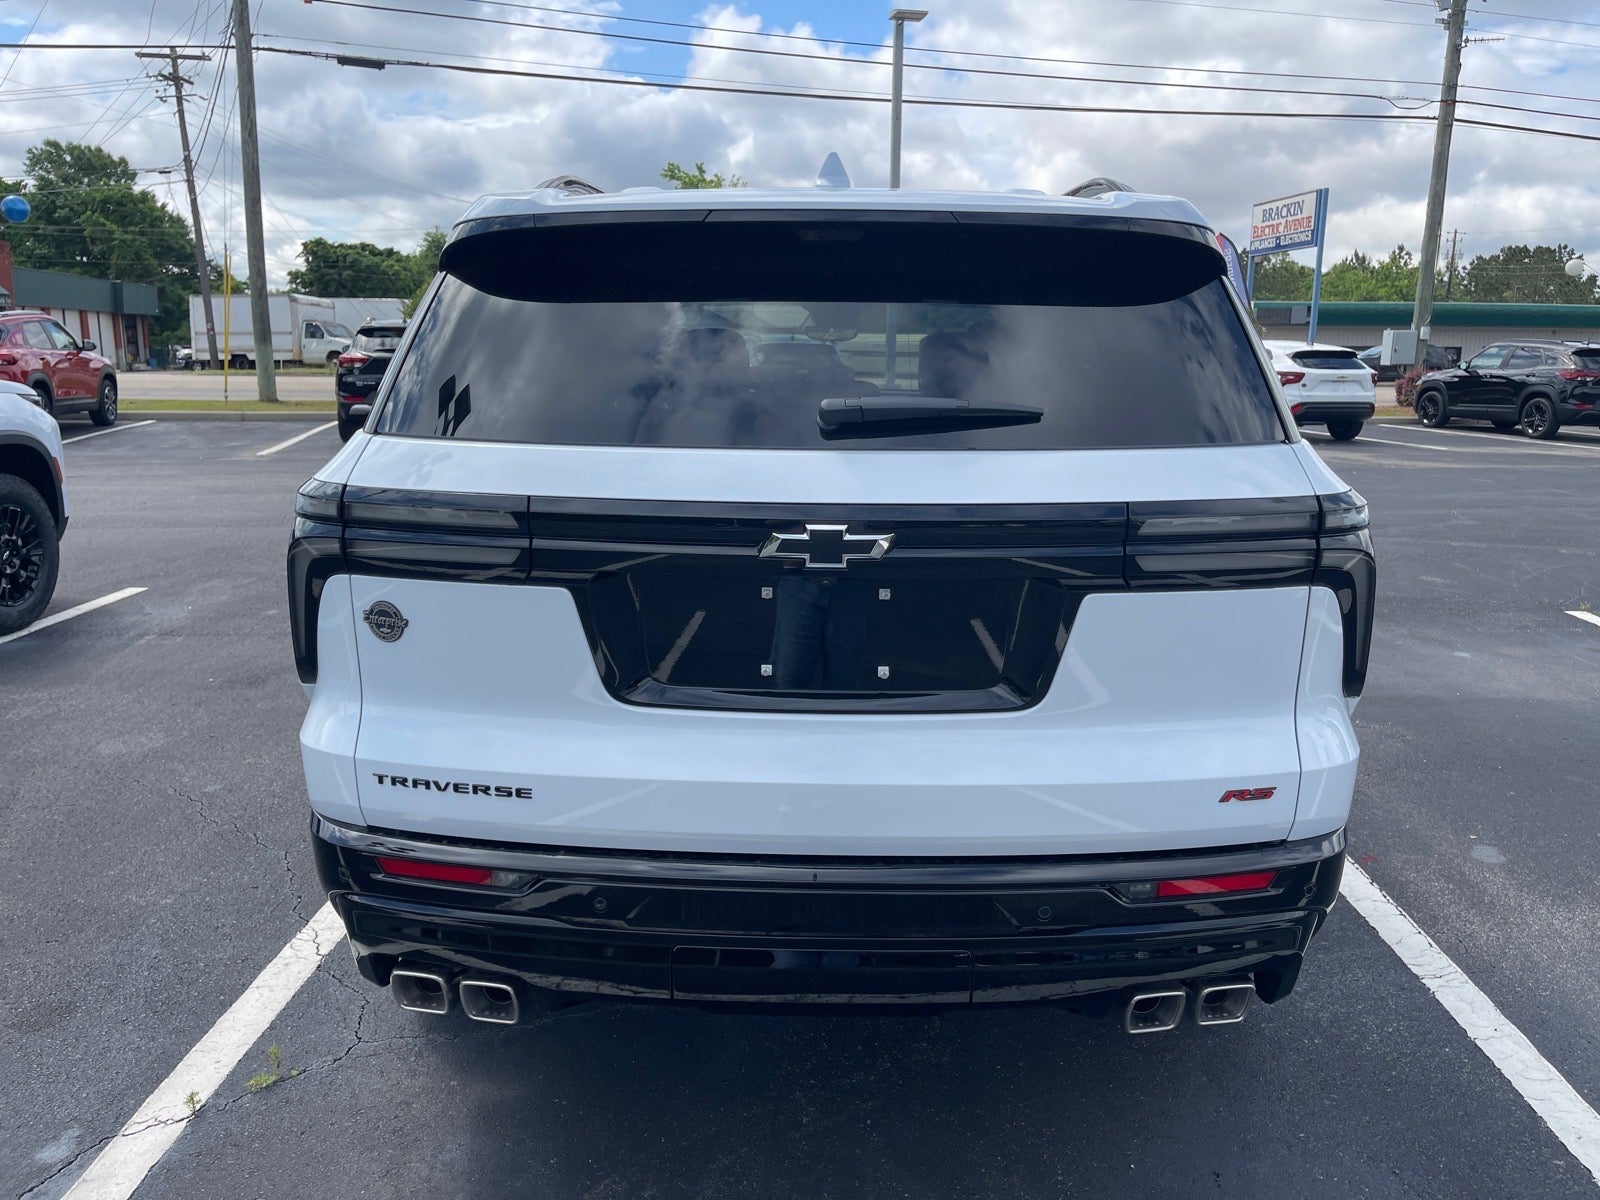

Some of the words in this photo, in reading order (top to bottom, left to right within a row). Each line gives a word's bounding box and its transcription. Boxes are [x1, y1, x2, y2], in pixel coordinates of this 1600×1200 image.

[1261, 200, 1304, 223] BRACKIN
[1252, 222, 1282, 239] ELECTRIC
[1282, 215, 1313, 234] AVENUE
[1251, 237, 1276, 251] APPLIANCES
[1280, 230, 1312, 246] ELECTRONICS
[362, 610, 408, 628] Enterprise
[372, 773, 533, 800] TRAVERSE
[1218, 786, 1277, 802] RS
